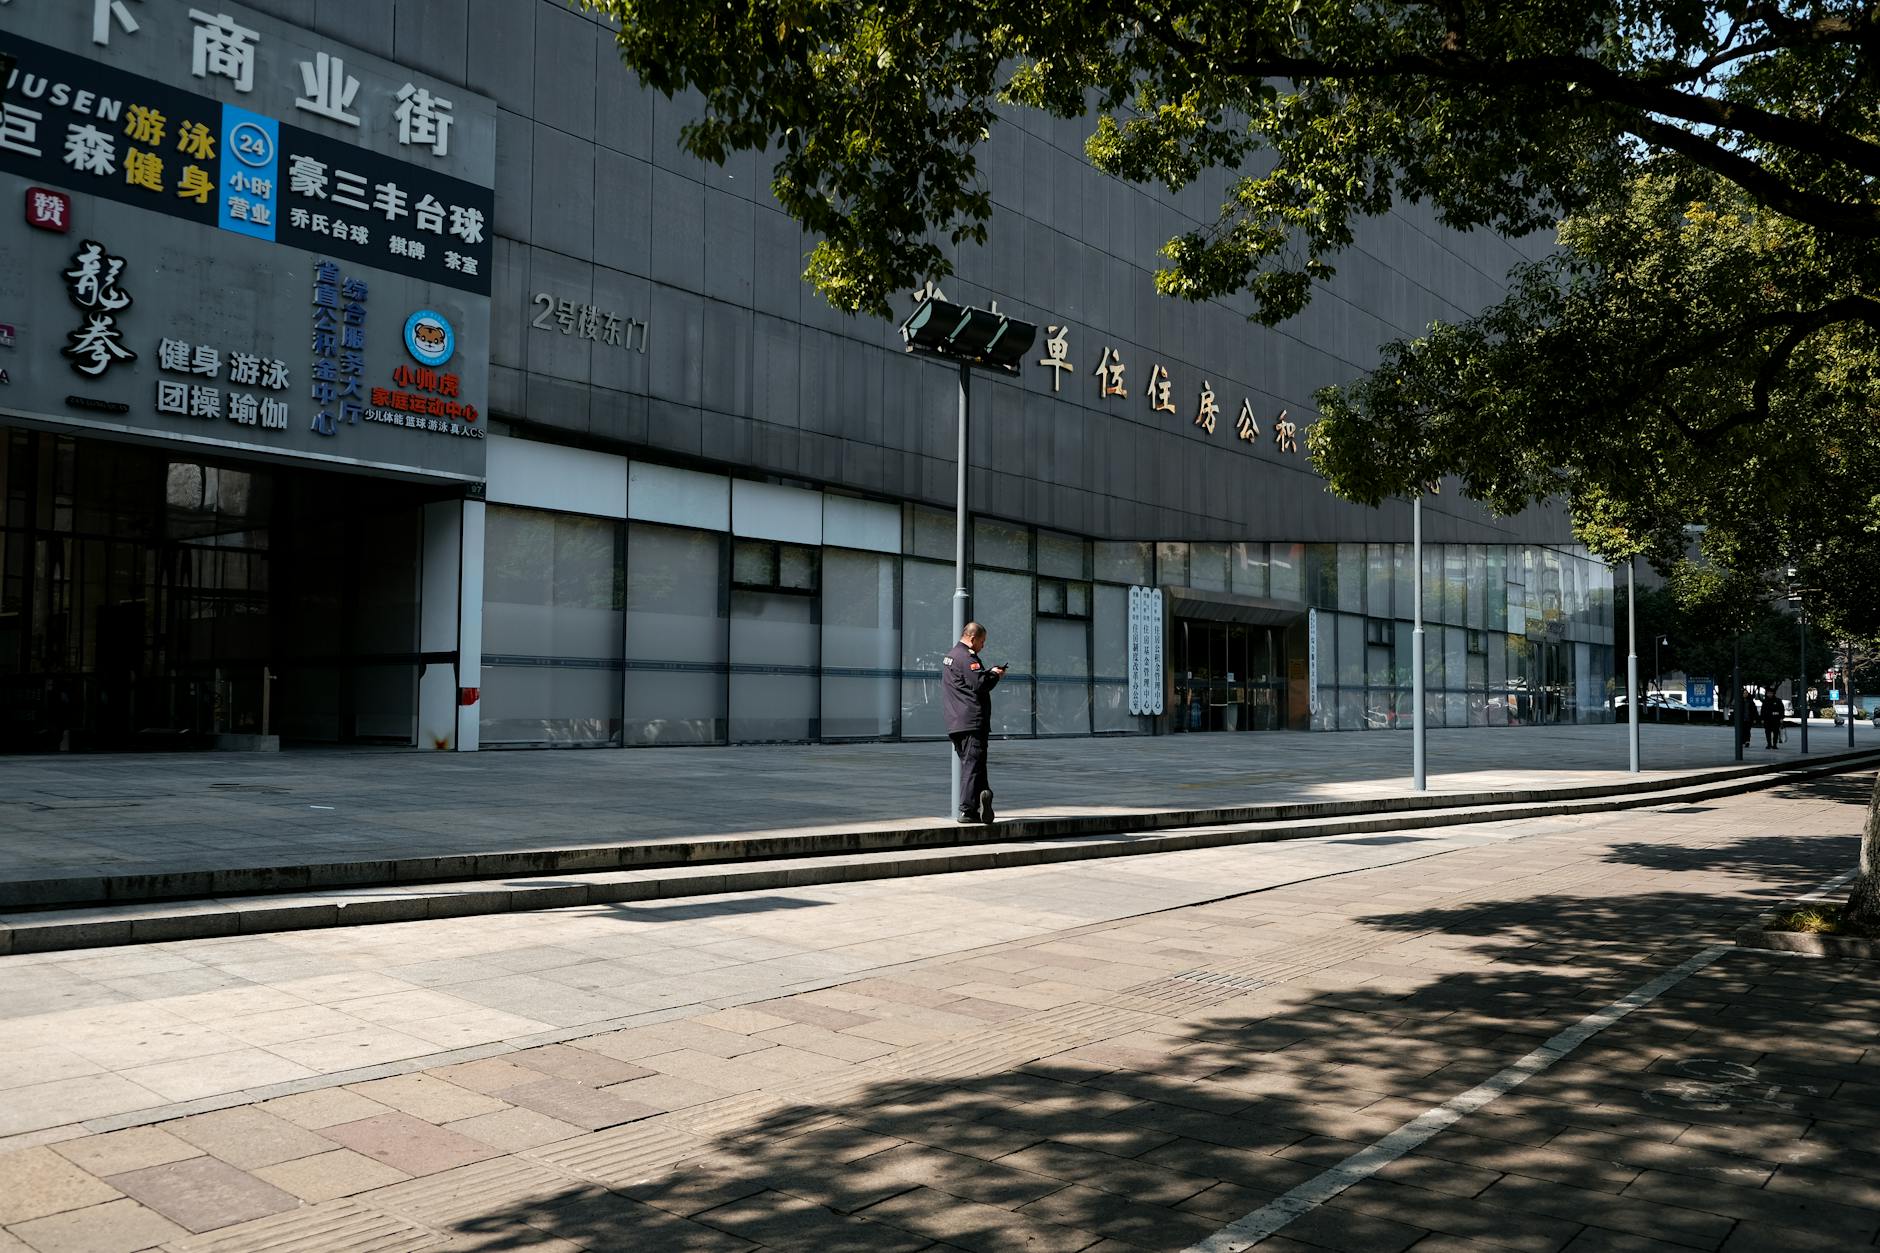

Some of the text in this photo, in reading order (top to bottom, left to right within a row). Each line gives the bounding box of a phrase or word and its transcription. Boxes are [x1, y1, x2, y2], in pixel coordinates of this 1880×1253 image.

[124, 103, 216, 160] 游泳
[239, 134, 265, 157] 24
[123, 147, 215, 204] 健身
[229, 171, 272, 200] 小时
[289, 153, 484, 243] 豪三丰台球
[228, 196, 271, 226] 营业
[290, 207, 479, 276] 乔氏台球 棋牌 茶室
[310, 259, 340, 436] 省直公积金中心
[532, 292, 649, 354] 2号楼东门
[158, 337, 290, 390] 健身 游泳
[338, 277, 369, 425] 综合服务大厅
[157, 380, 288, 430] 团操 瑜伽
[371, 387, 478, 422] 家庭运动中心
[393, 365, 460, 397] 小帅虎
[364, 408, 404, 426] 少儿体能
[450, 425, 485, 440] 真人CS
